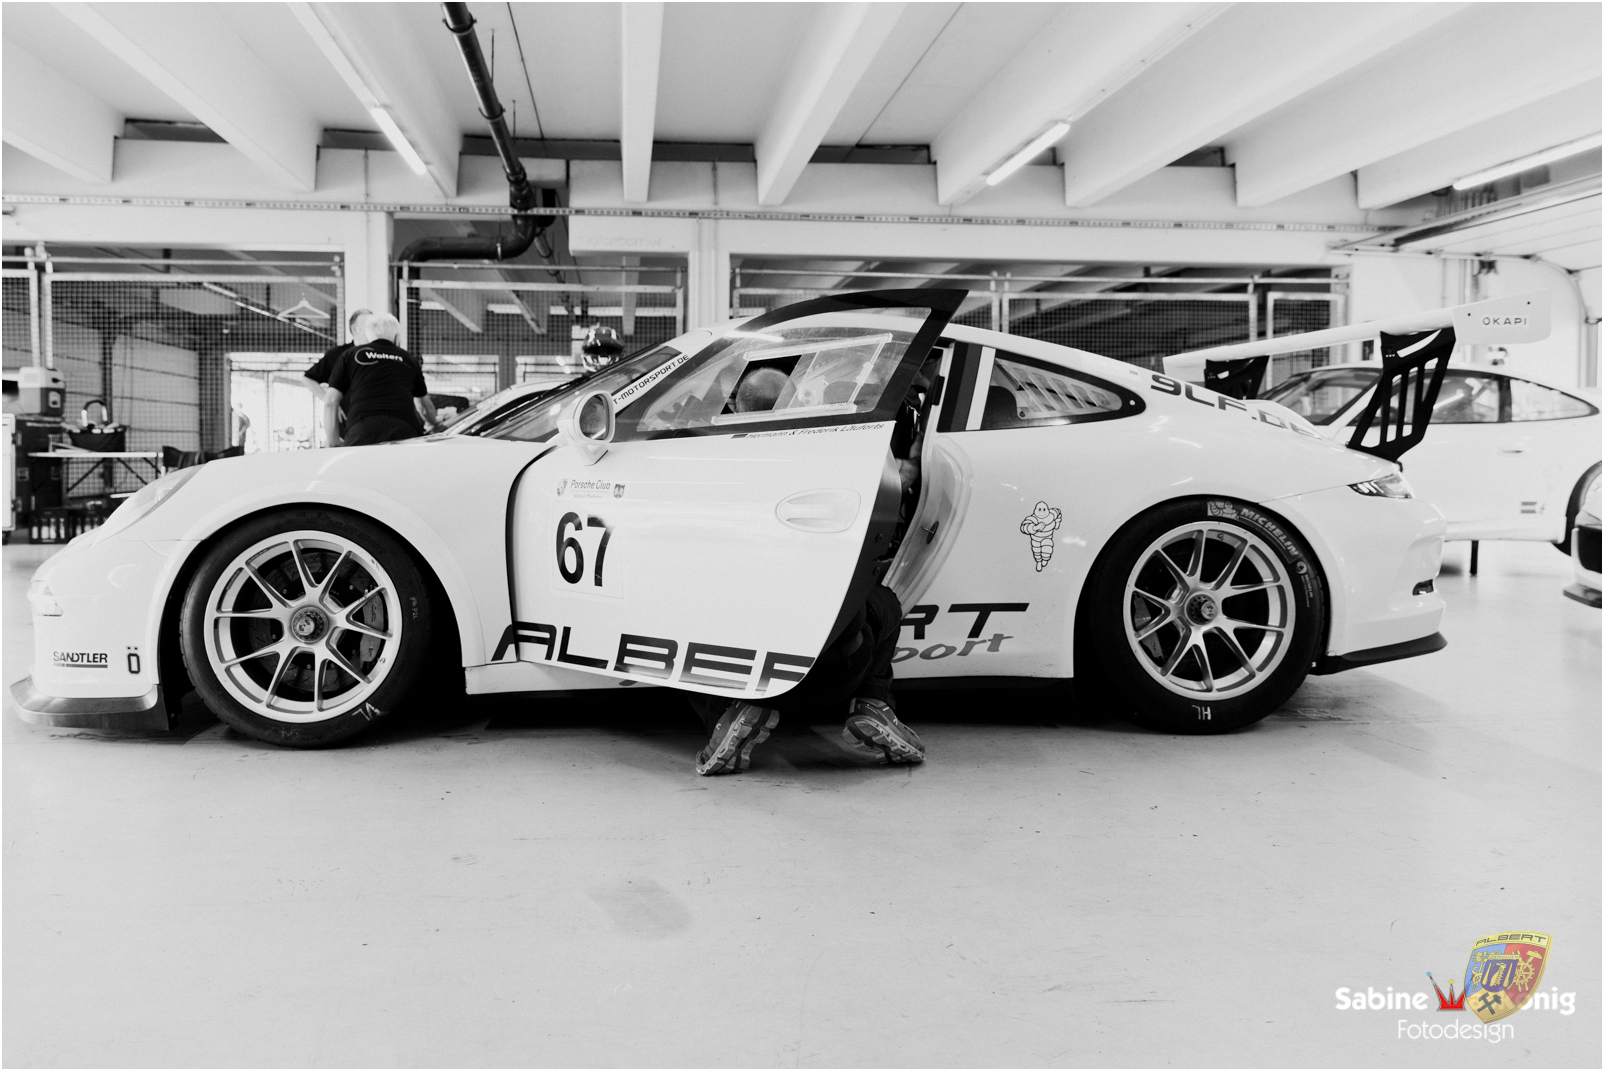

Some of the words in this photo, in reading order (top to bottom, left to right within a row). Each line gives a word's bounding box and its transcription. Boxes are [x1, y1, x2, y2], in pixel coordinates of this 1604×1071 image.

[1482, 316, 1527, 326] OKAPI
[570, 479, 596, 490] Porsche
[595, 479, 611, 490] Club
[1240, 507, 1299, 557] MICHELIN
[556, 511, 615, 587] 67
[53, 651, 108, 663] SANDTLER
